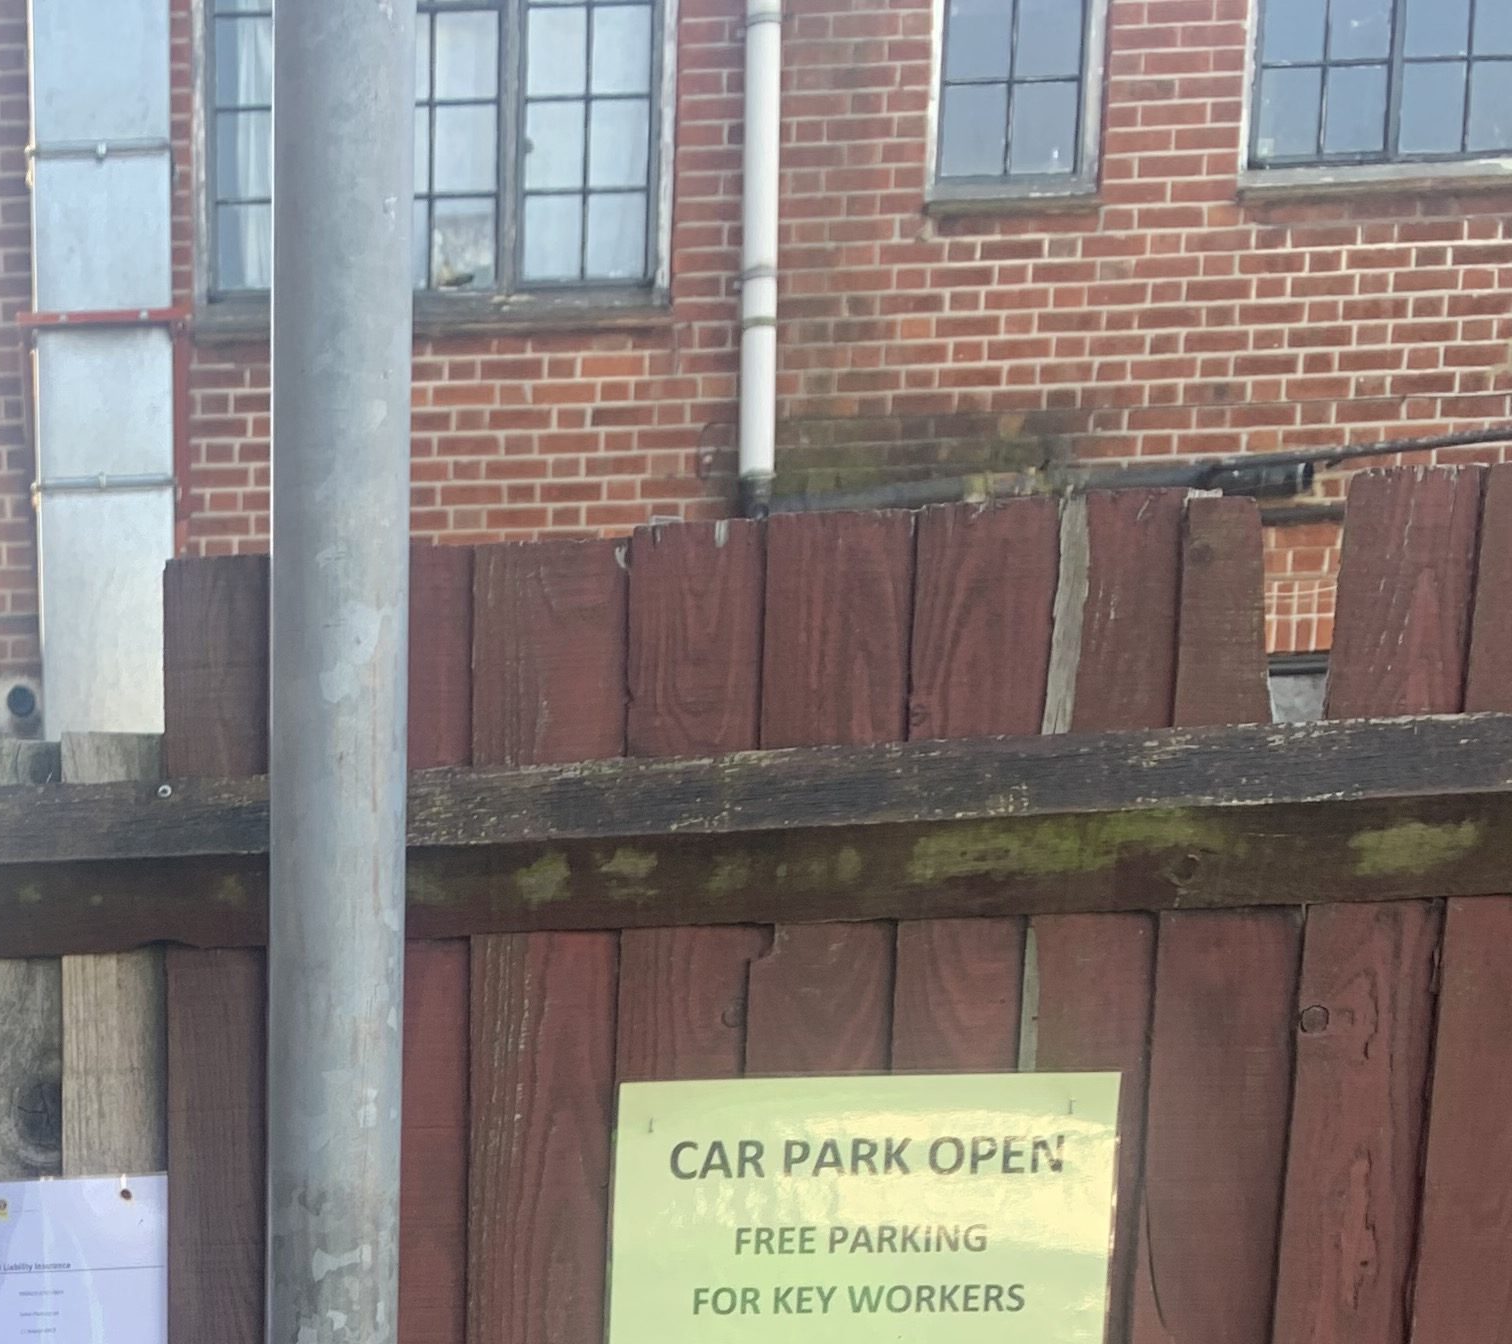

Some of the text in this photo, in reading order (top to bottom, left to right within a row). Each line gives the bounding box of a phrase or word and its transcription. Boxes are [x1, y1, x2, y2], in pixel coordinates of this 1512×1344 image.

[669, 1133, 1066, 1181] CAR PARK OPEN
[734, 1223, 988, 1256] FREE PARKING
[692, 1283, 1026, 1316] FOR KEY WORKERS
